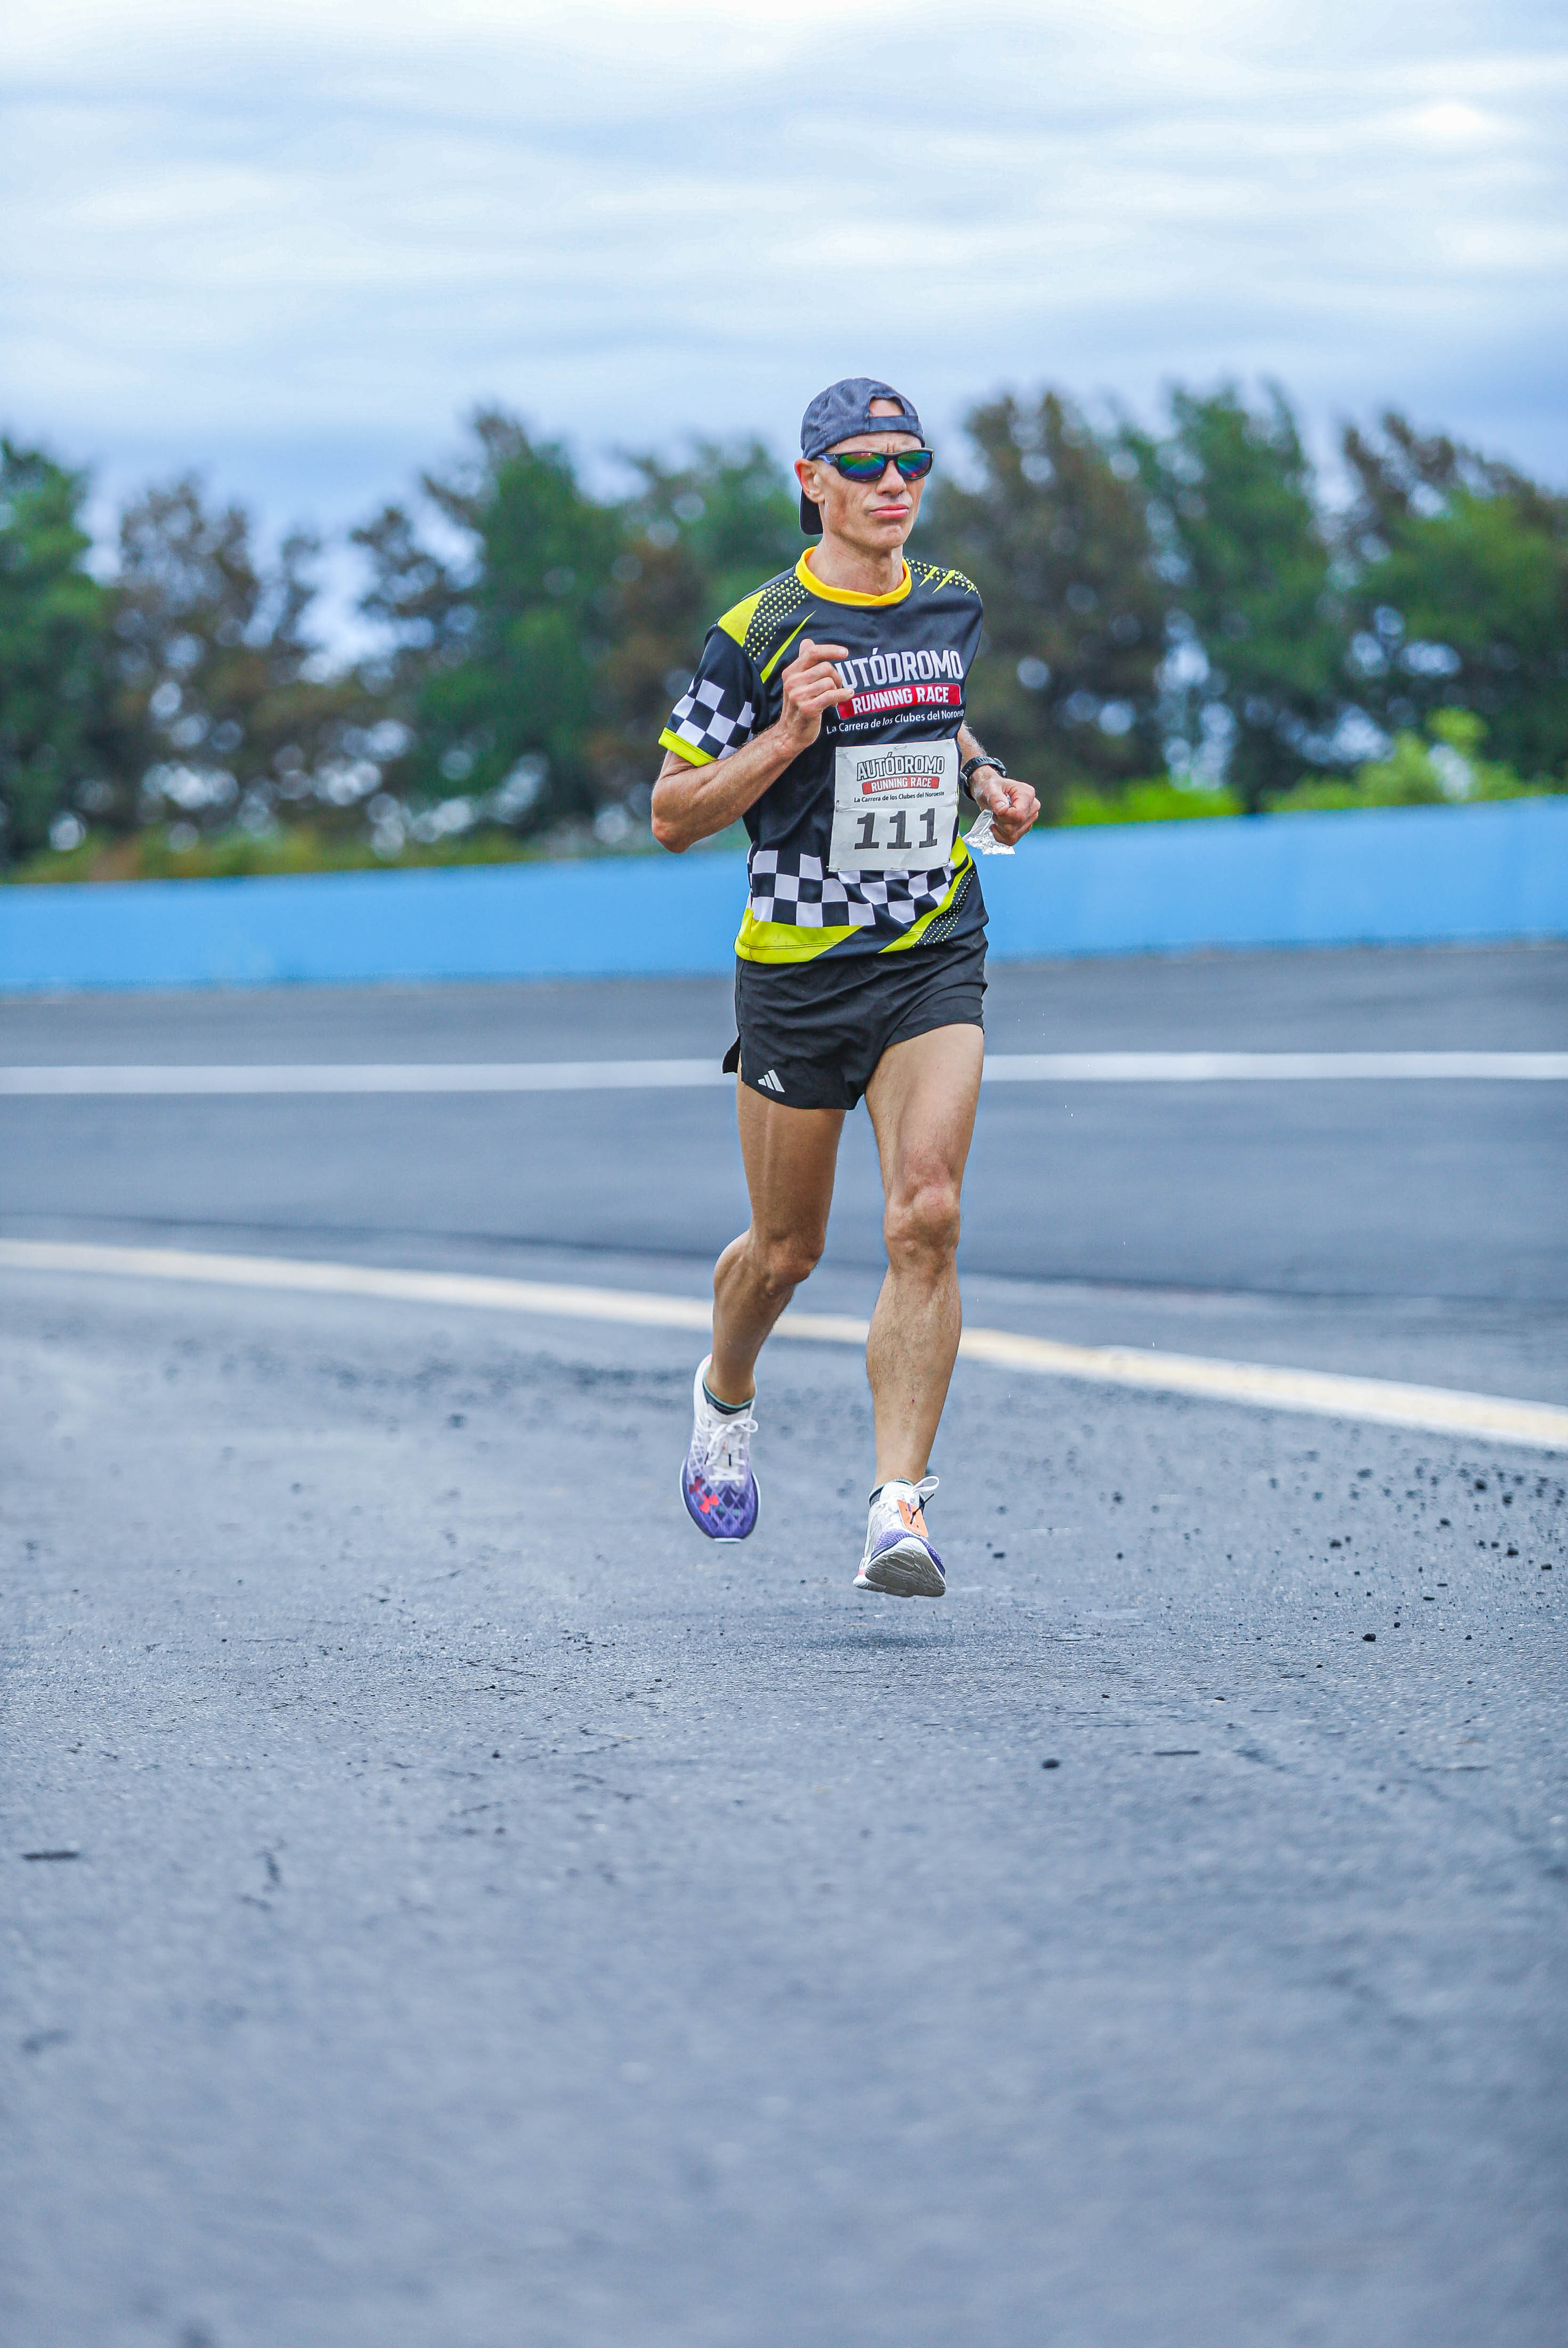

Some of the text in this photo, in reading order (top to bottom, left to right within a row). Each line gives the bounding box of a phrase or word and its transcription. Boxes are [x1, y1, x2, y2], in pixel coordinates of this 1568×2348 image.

[834, 647, 964, 689] UTÓDROMO
[851, 686, 949, 714] RUNNING RACE
[826, 725, 837, 734] La
[839, 722, 869, 732] Carrera
[871, 719, 881, 728] de
[882, 717, 893, 726] los
[895, 712, 925, 723] Clubes
[927, 710, 940, 720] del
[856, 751, 945, 781] AUTÓDROMO
[871, 777, 932, 792] RUNNING RACE
[854, 807, 938, 850] 111
